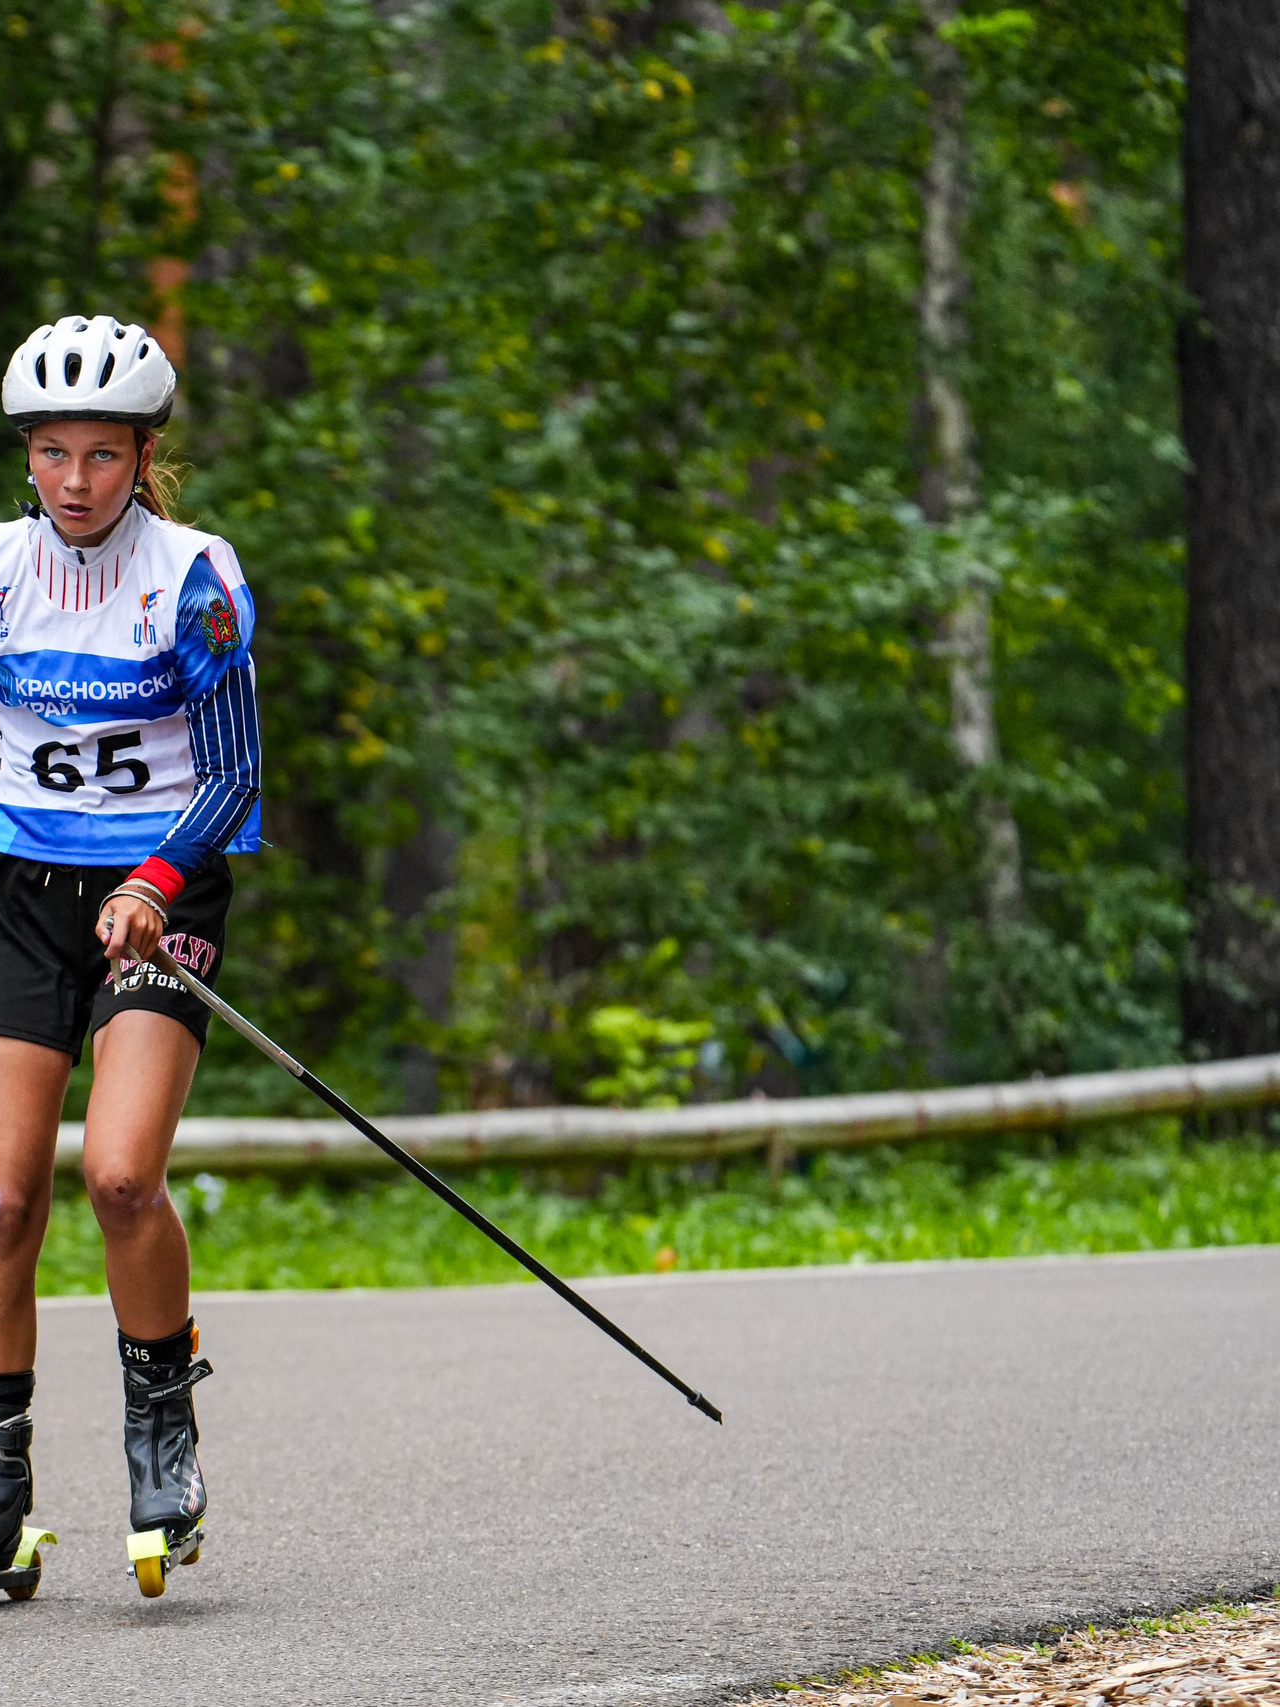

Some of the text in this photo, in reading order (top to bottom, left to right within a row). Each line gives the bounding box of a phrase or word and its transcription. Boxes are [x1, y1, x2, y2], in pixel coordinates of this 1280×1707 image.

[14, 666, 180, 701] КРАСНОЯРСКИ
[30, 729, 151, 795] 65
[125, 1343, 150, 1362] 215
